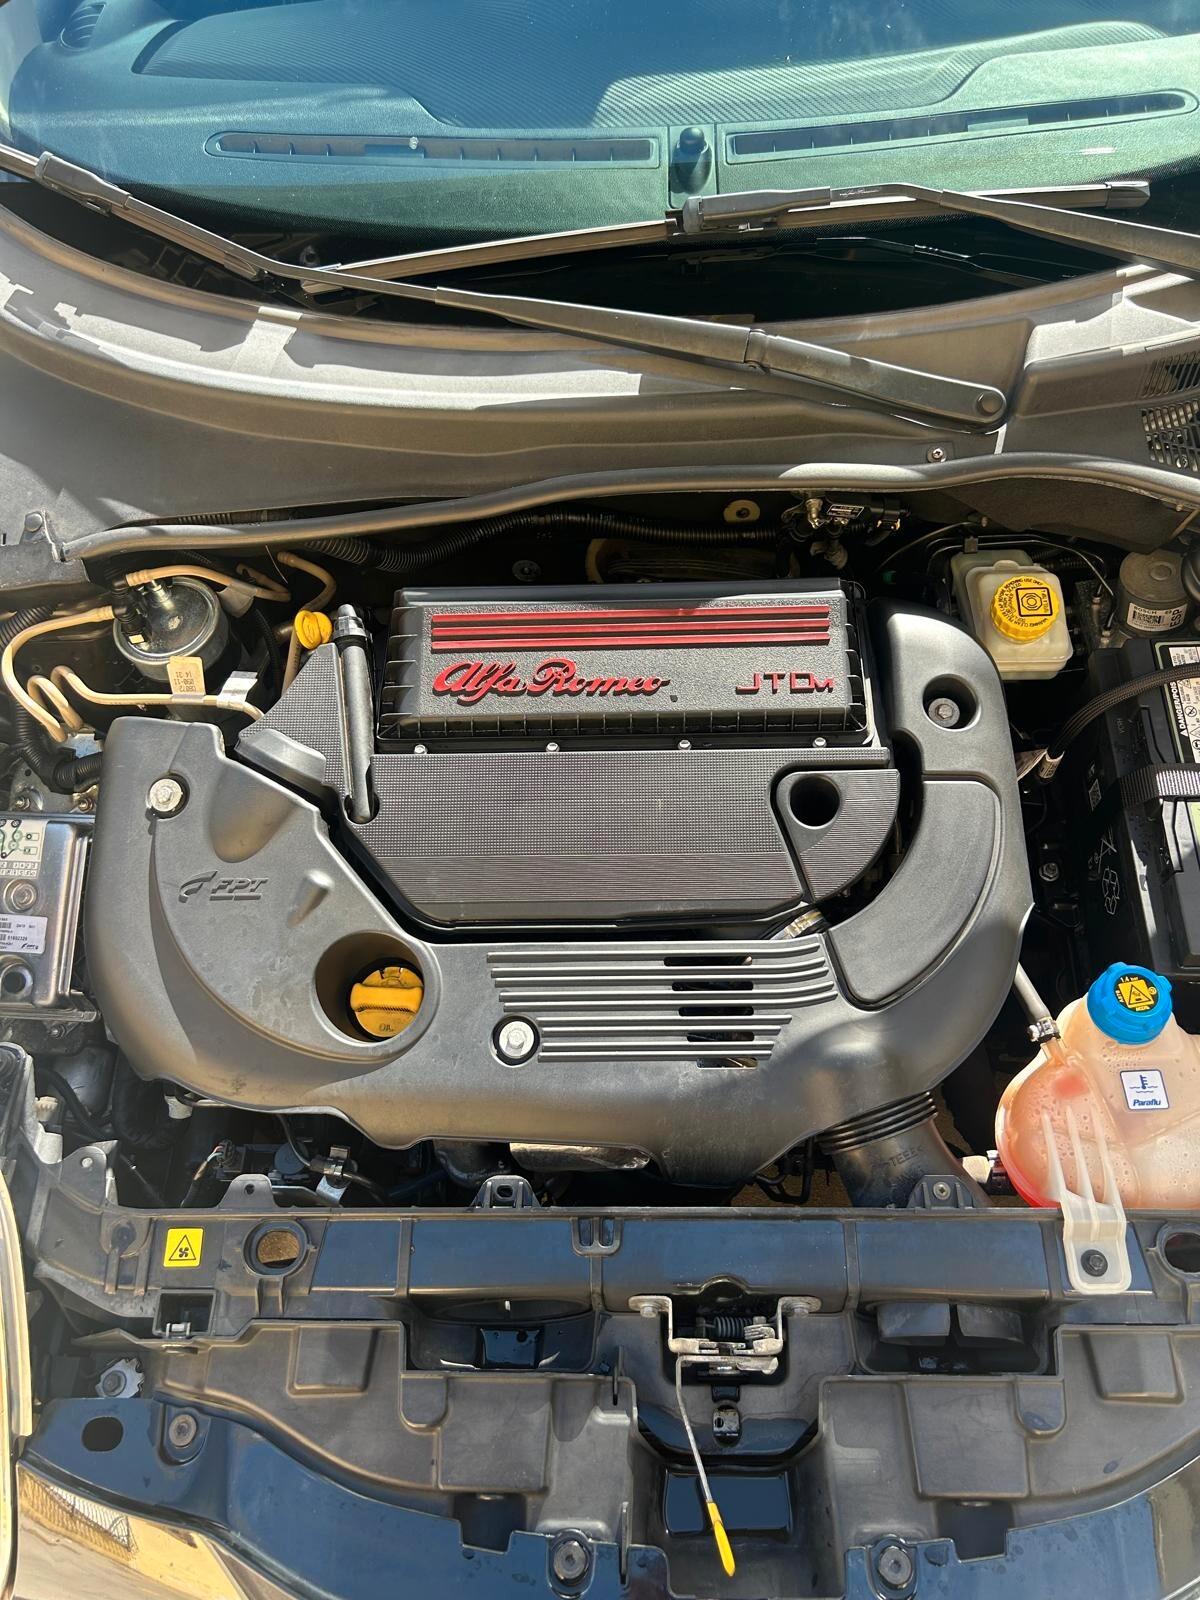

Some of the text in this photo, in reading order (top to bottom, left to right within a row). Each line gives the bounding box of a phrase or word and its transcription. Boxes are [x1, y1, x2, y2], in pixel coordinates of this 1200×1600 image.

[1169, 609, 1183, 628] ESP
[432, 657, 671, 707] Alfa Romeo
[1169, 681, 1187, 730] DANGER/POIS
[210, 877, 269, 895] FPT
[1132, 1098, 1162, 1107] Paraflu
